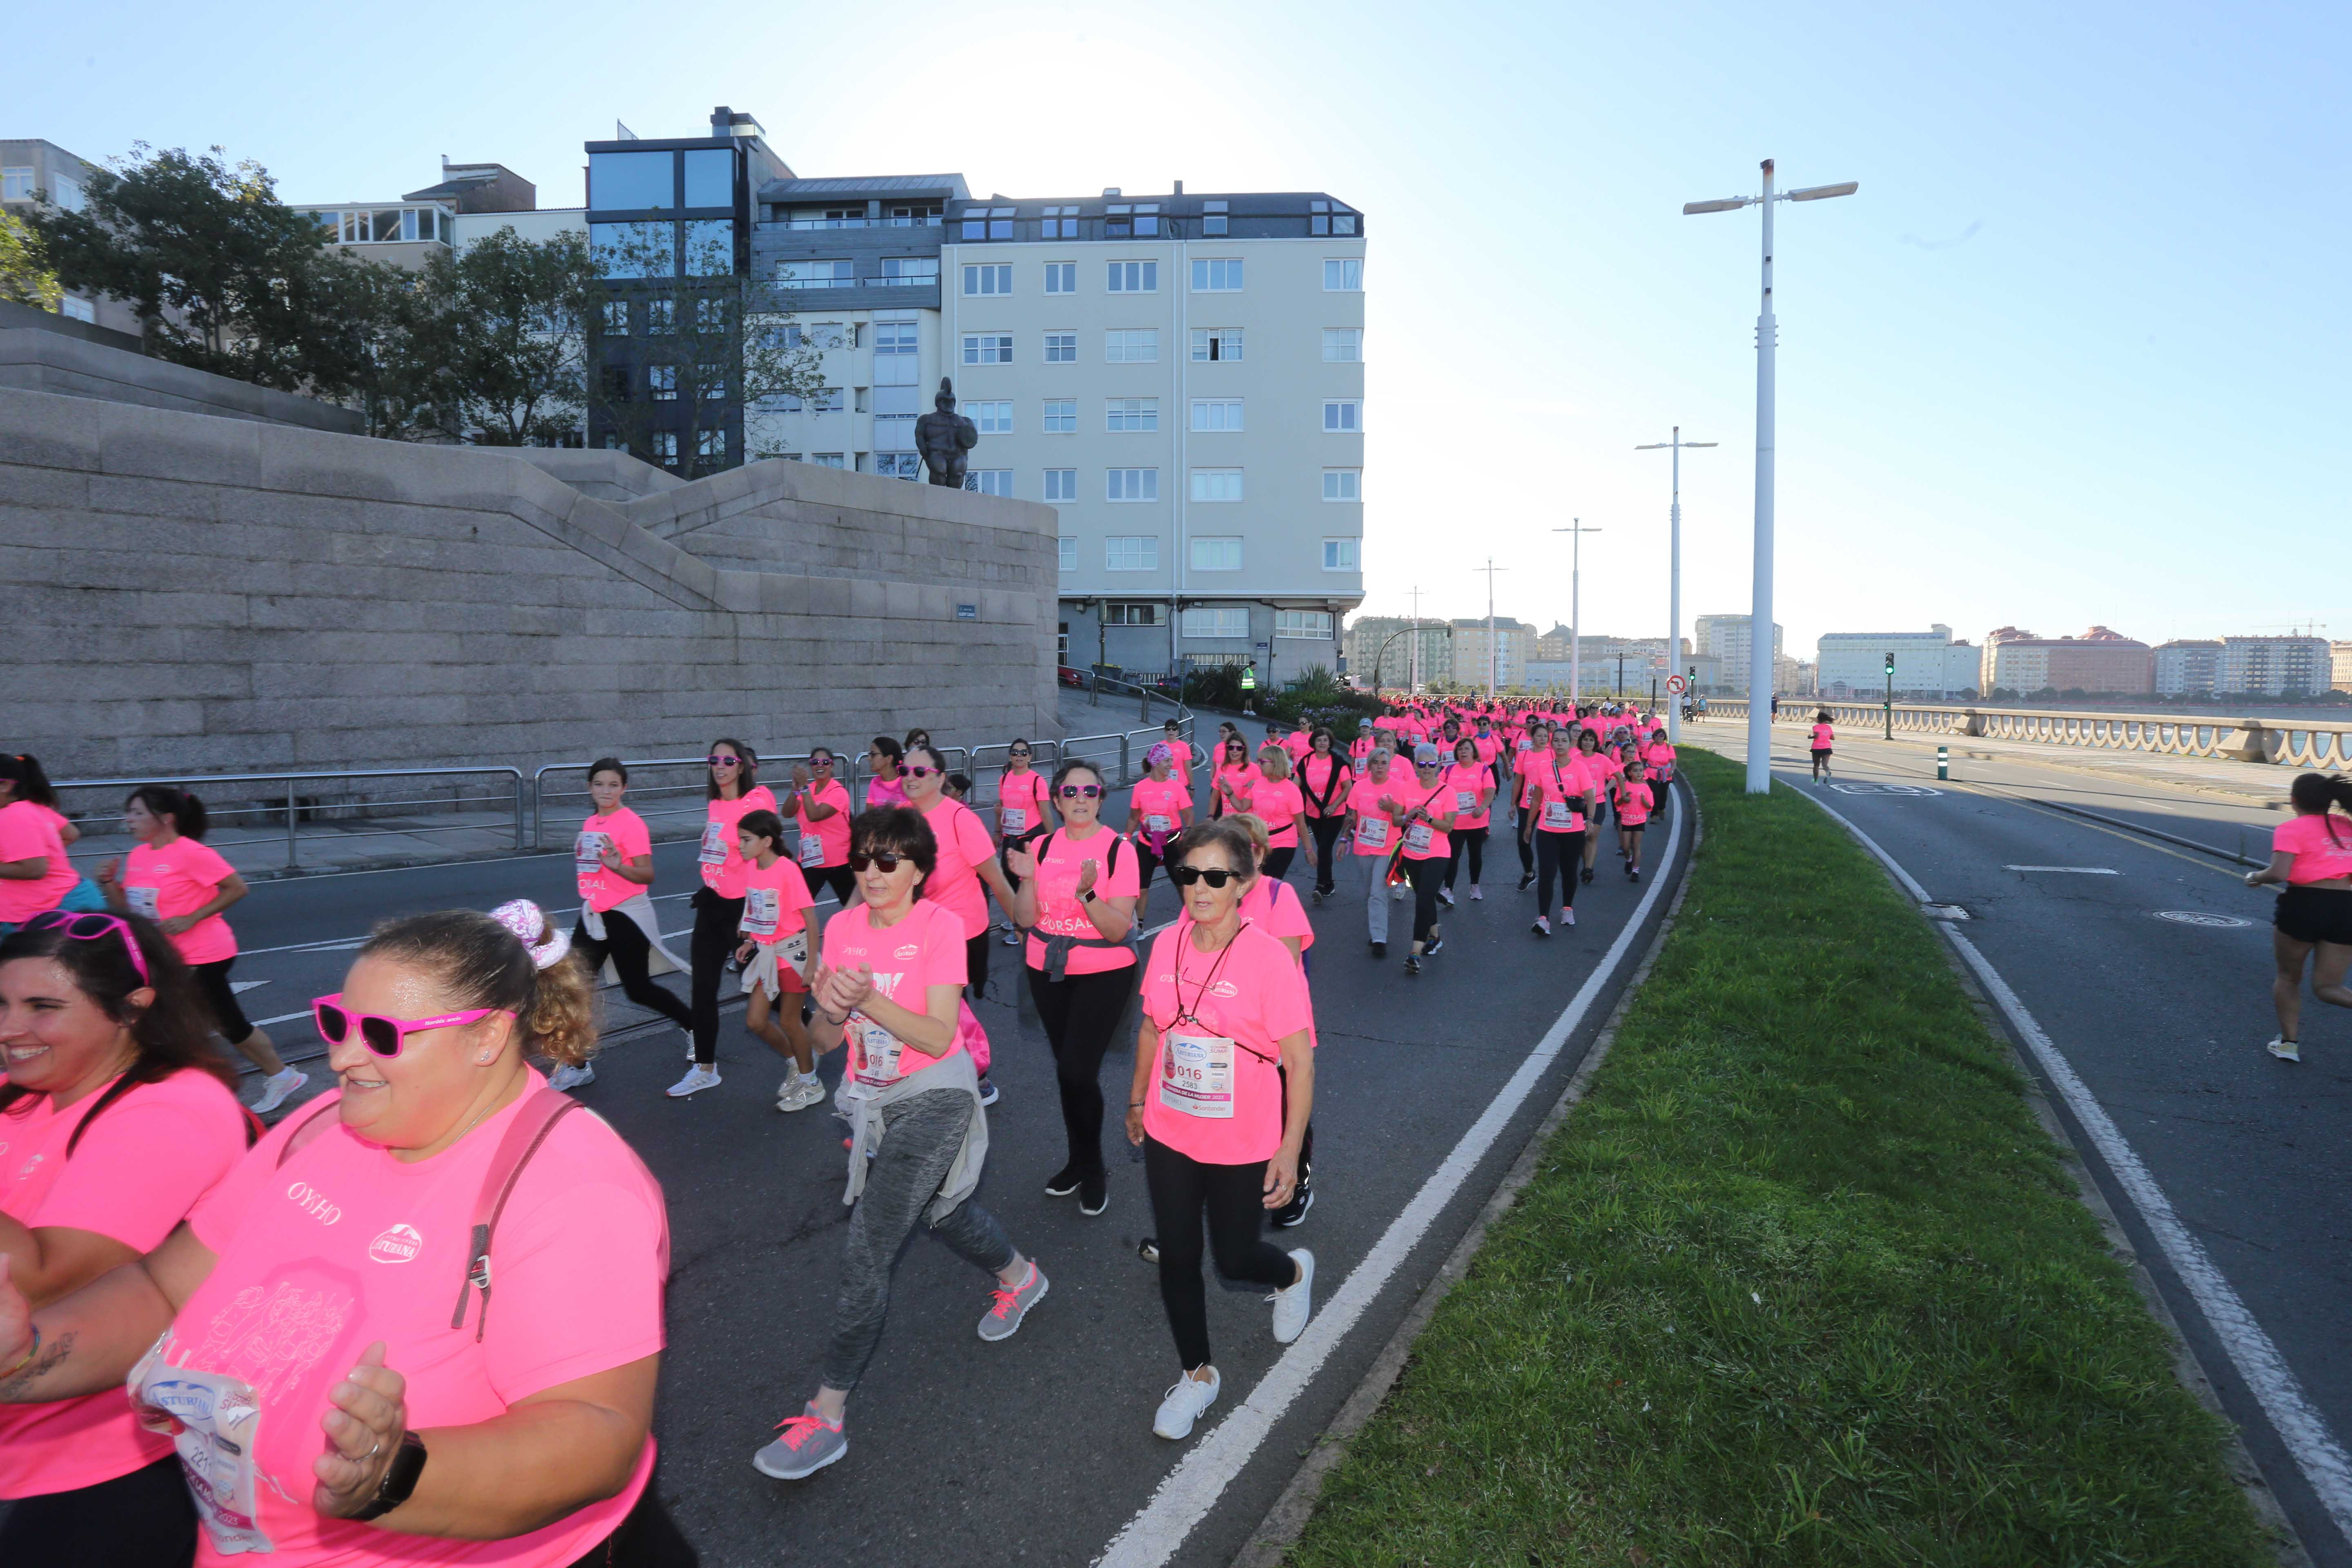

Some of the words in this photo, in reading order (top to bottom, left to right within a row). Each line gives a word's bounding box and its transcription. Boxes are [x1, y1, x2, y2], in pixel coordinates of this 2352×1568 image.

[1846, 785, 1922, 793] 50
[1042, 914, 1094, 931] DORSAL
[1176, 1047, 1204, 1058] ASTURIANA
[869, 1054, 882, 1067] 016
[1177, 1065, 1202, 1080] 016
[1182, 1080, 1198, 1089] 2583
[288, 1182, 341, 1225] OYSHO
[218, 1511, 238, 1525] 2023
